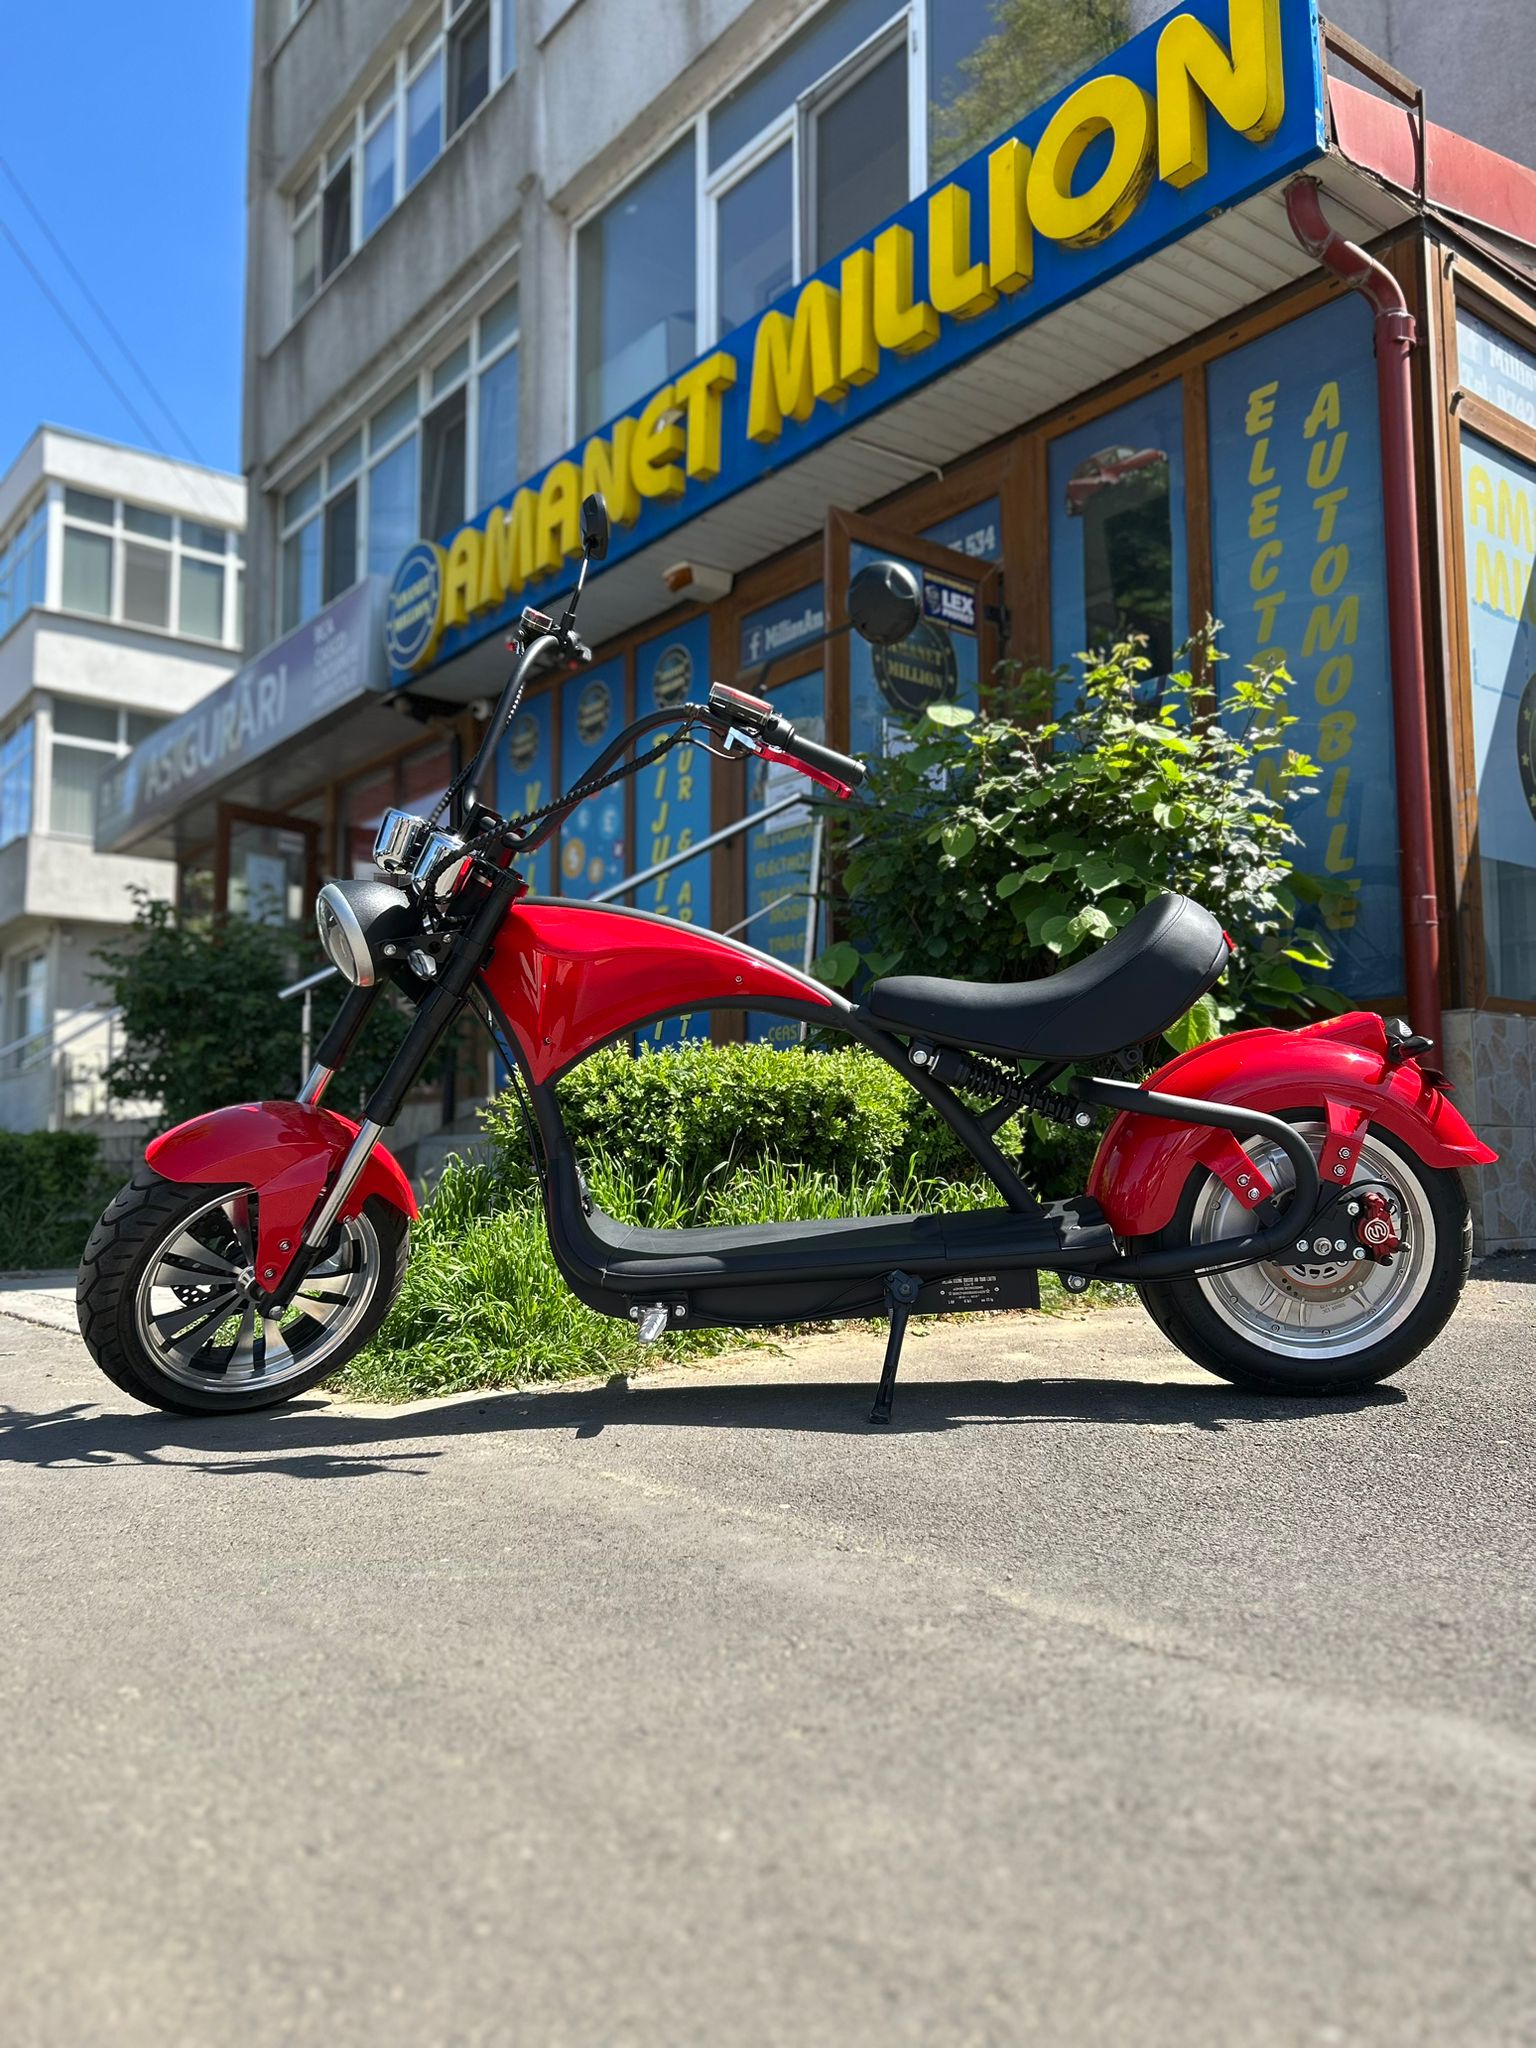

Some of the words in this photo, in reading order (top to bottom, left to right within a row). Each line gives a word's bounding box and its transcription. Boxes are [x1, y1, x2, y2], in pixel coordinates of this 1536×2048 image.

[444, 352, 737, 628] AMANET
[746, 0, 1285, 445] MILLION
[941, 588, 974, 617] LEX
[1301, 381, 1361, 930] AUTOMOBILE
[768, 1023, 801, 1043] CEAS
